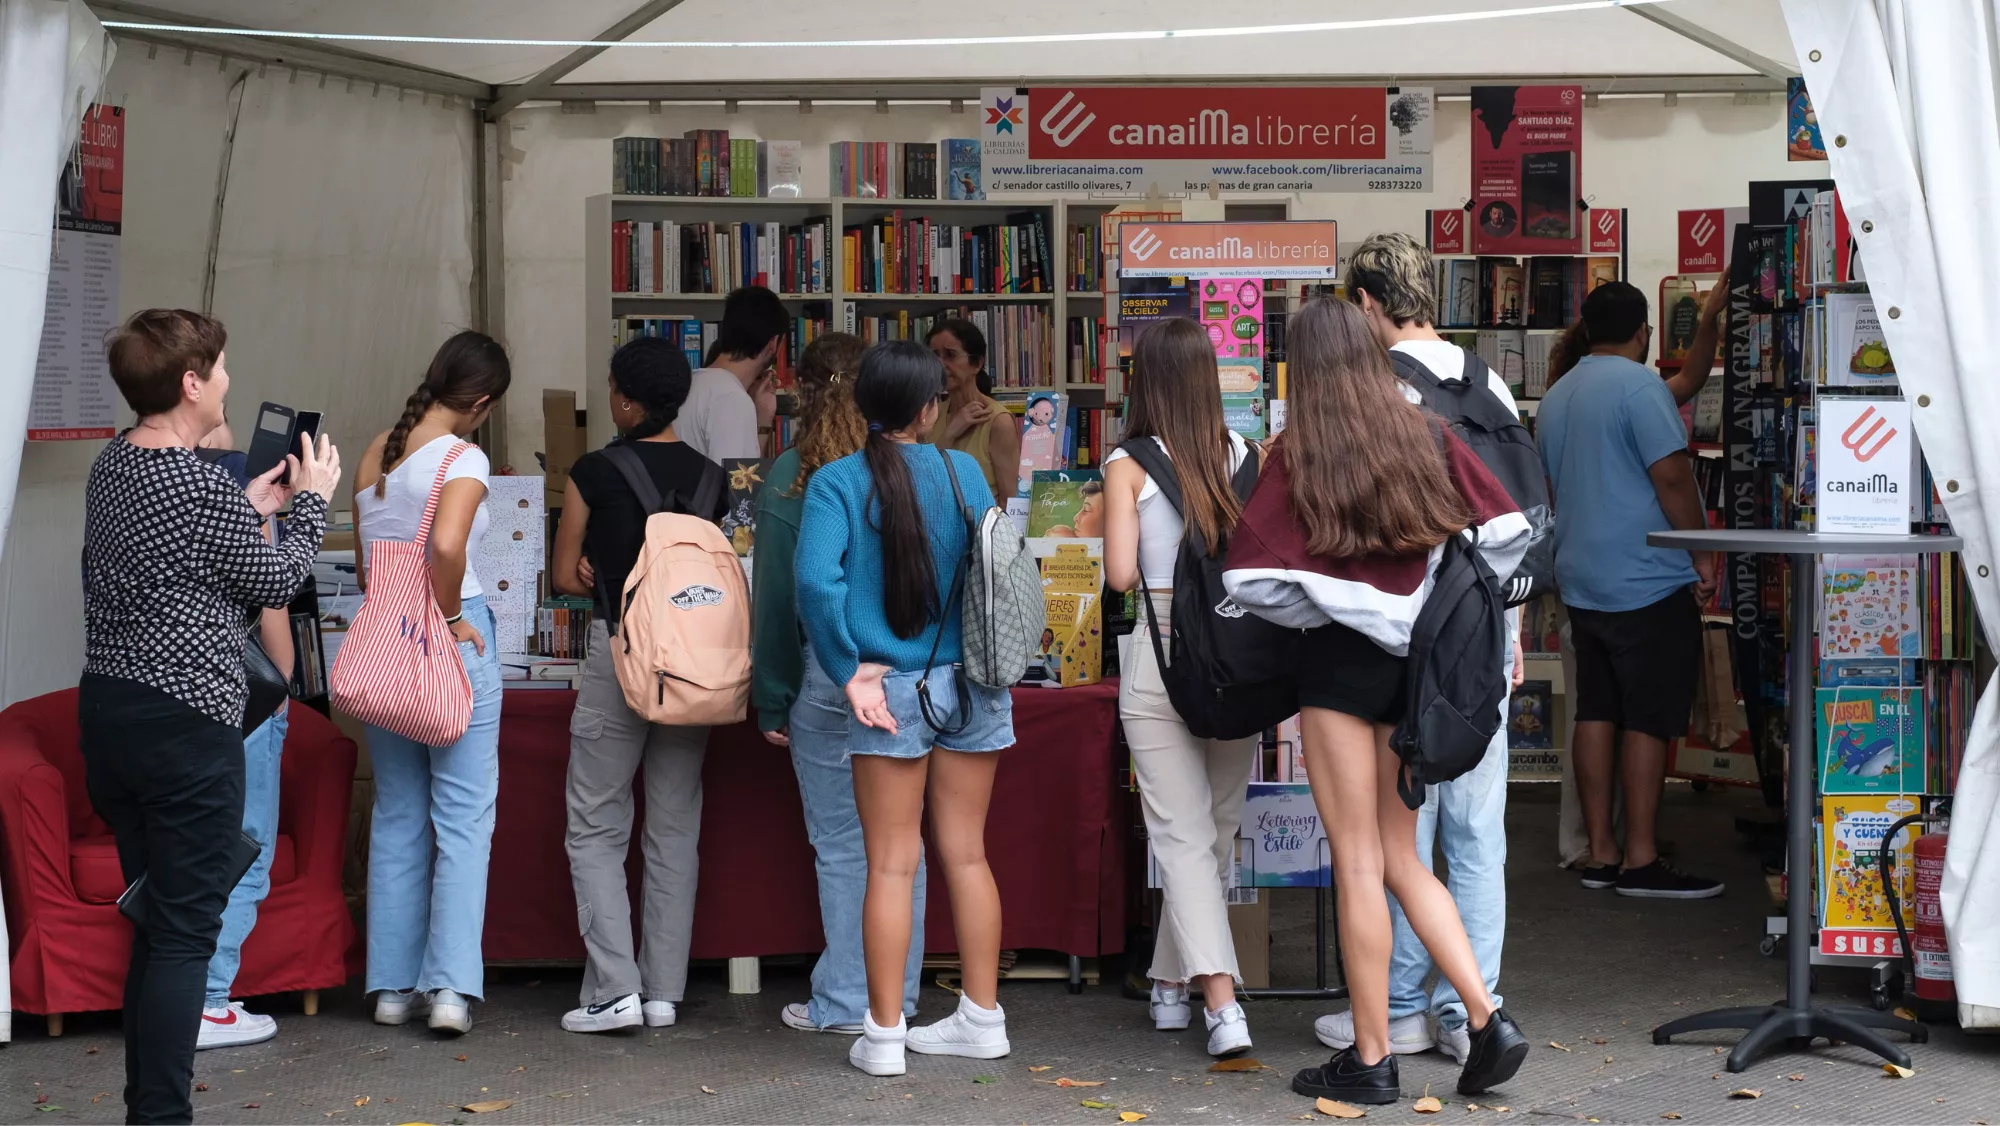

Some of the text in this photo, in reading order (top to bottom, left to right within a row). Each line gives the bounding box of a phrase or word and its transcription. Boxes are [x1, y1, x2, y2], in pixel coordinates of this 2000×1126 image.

[1518, 116, 1574, 126] SANTIAGO DÍAZ,
[93, 122, 118, 149] LIBRO
[1256, 114, 1376, 146] librería
[984, 140, 1025, 148] LIBRERÍAS
[992, 164, 1143, 175] www.libreriacanaima.com
[1212, 164, 1422, 176] www.facebook.com/libreriacanaima
[992, 180, 1132, 191] c/ senador castillo olivares, 7
[1184, 180, 1313, 192] las pamas de gran canaria
[1368, 180, 1422, 190] 928373220
[1256, 240, 1329, 259] librería
[1219, 268, 1322, 276] www.facebook.com/libreriacanaima
[1122, 300, 1168, 308] OBSERVAR
[1732, 283, 1757, 640] COMPATOS ANAGRAMA
[1039, 492, 1071, 513] Papá
[1010, 508, 1016, 516] El
[1826, 514, 1901, 522] www.libreriacanaima.com
[686, 587, 705, 596] VANS
[690, 594, 704, 602] THE
[1854, 596, 1882, 604] CUENTOS
[1046, 600, 1074, 613] JERES
[1833, 702, 1910, 721] BUSCA EN EL
[1876, 718, 1914, 736] MAR
[1510, 752, 1558, 764] arcombo
[1255, 811, 1318, 840] Lettering
[1852, 817, 1891, 828] BUSCA
[1844, 828, 1850, 838] Y
[1264, 832, 1304, 853] Estilo
